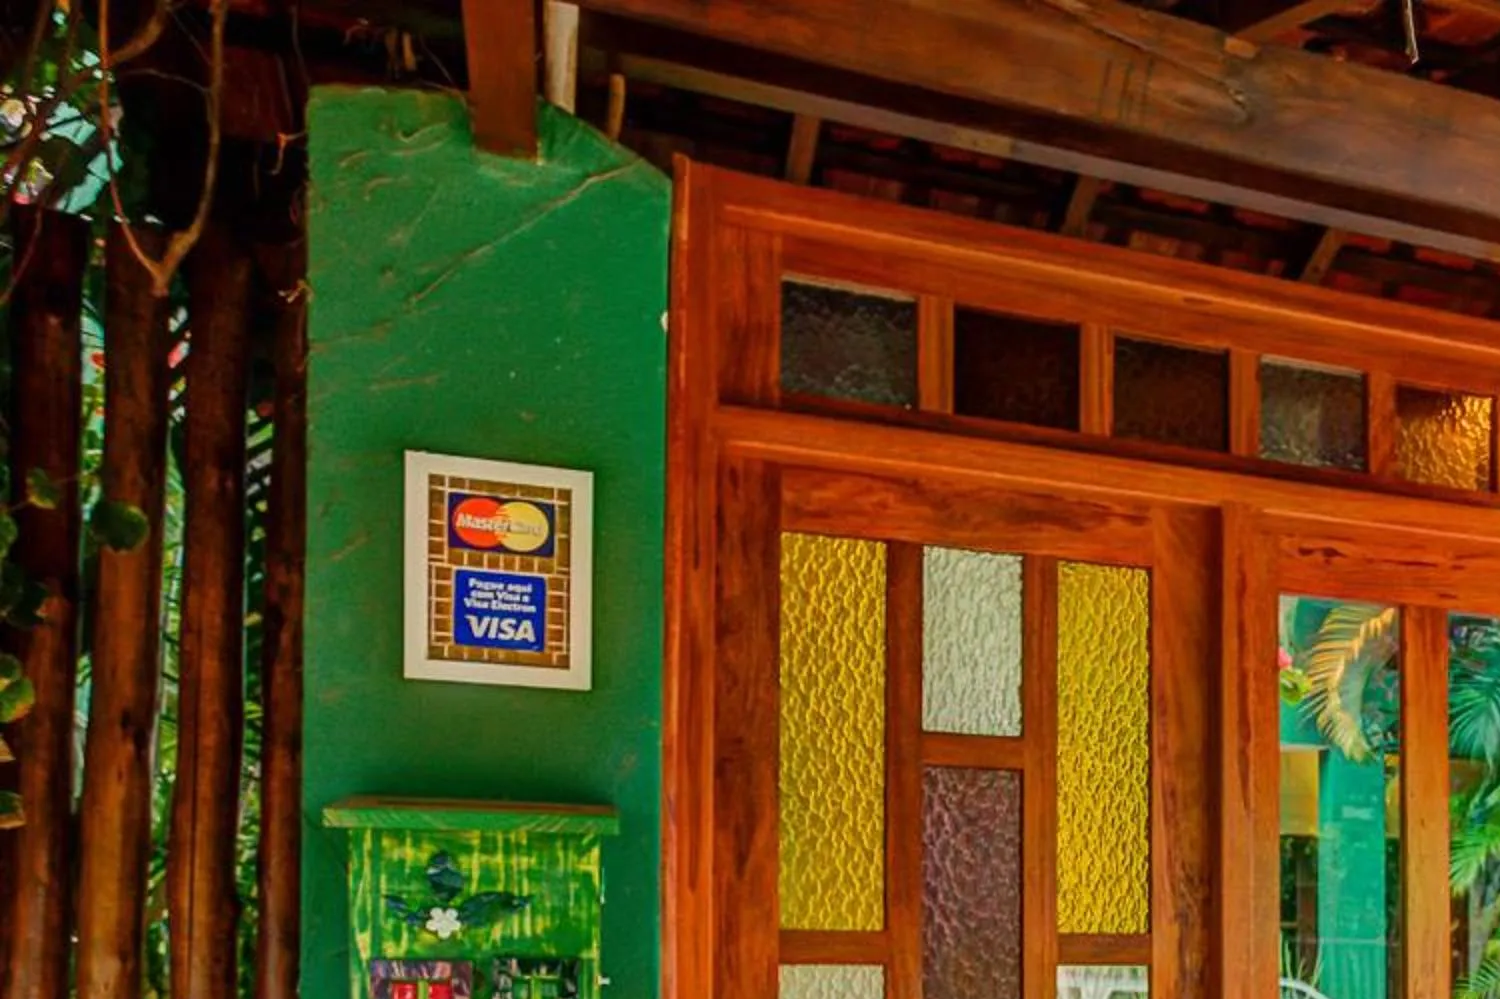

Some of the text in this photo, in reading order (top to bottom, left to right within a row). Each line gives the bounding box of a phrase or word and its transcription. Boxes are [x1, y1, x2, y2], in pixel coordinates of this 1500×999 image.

[456, 513, 543, 536] MasterCard
[468, 578, 532, 594] Pague aqui
[471, 591, 495, 600] com
[496, 591, 521, 601] Visa
[464, 598, 537, 612] Visa Electron
[464, 615, 536, 642] VISA
